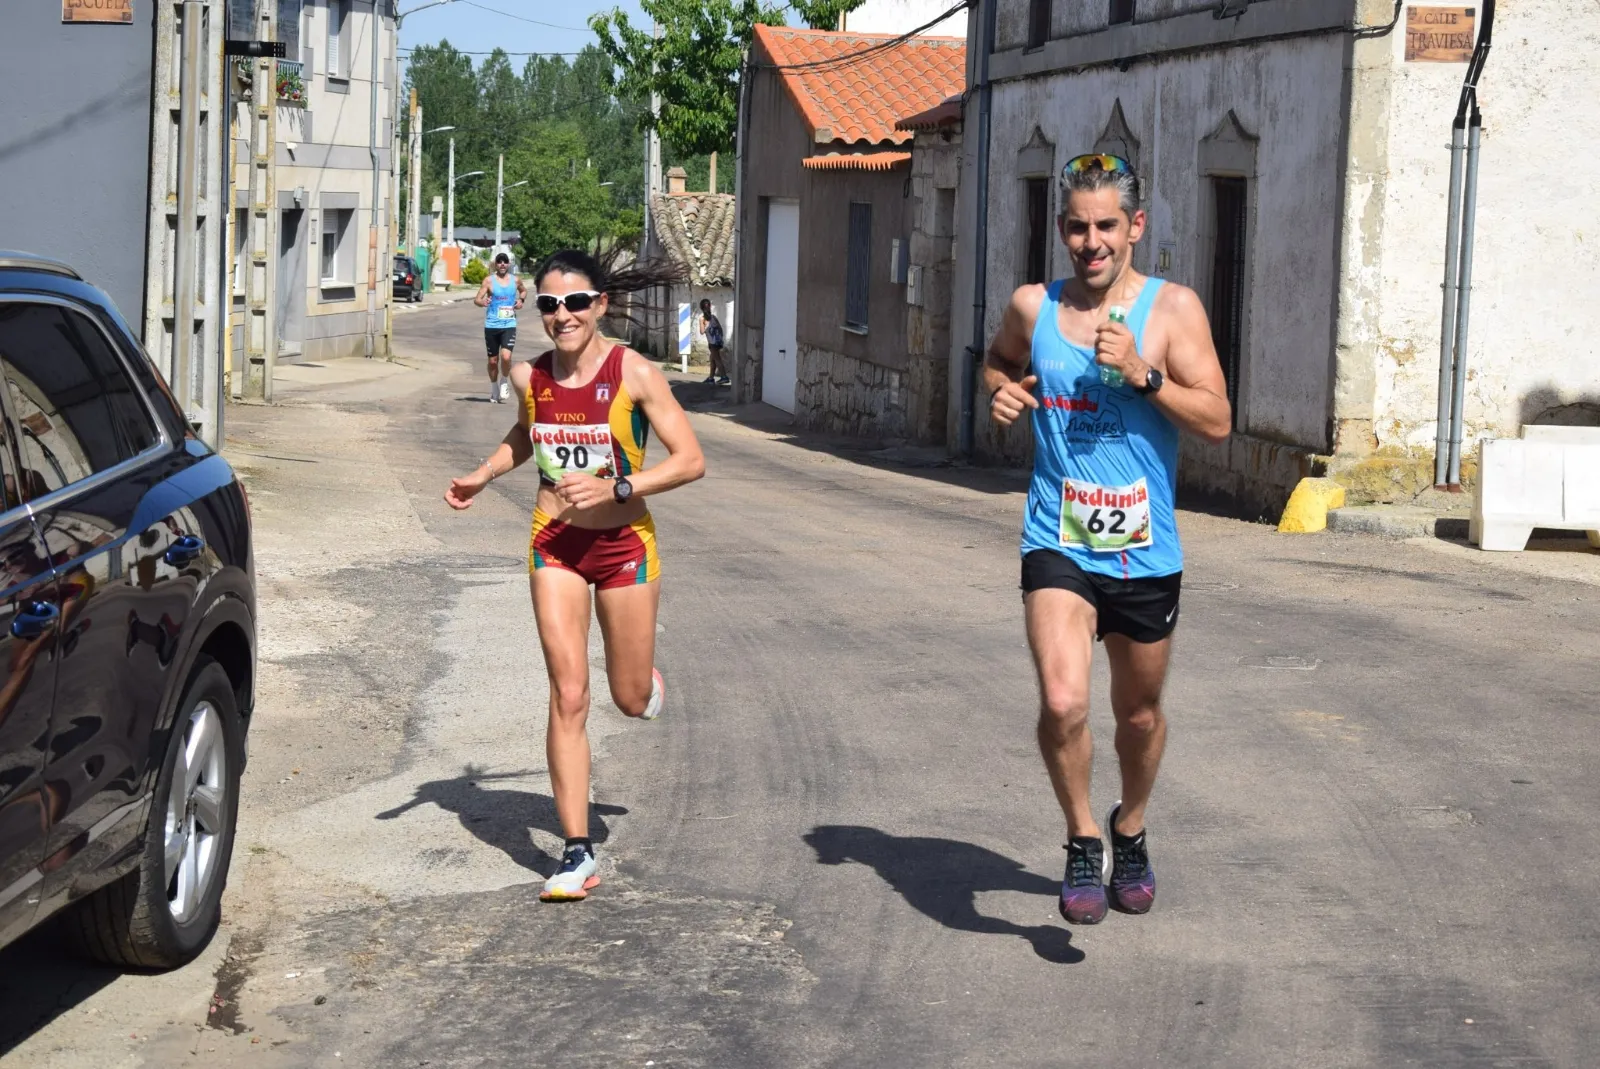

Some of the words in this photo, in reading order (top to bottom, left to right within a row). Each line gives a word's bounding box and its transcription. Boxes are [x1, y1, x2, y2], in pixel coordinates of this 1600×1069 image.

[1424, 13, 1457, 24] CALLE
[1409, 32, 1472, 49] TRAVIESA
[555, 413, 586, 422] VINO
[1066, 417, 1118, 434] FLOWERS
[532, 427, 610, 445] bedunia
[556, 446, 588, 469] 90
[1087, 509, 1126, 534] 62
